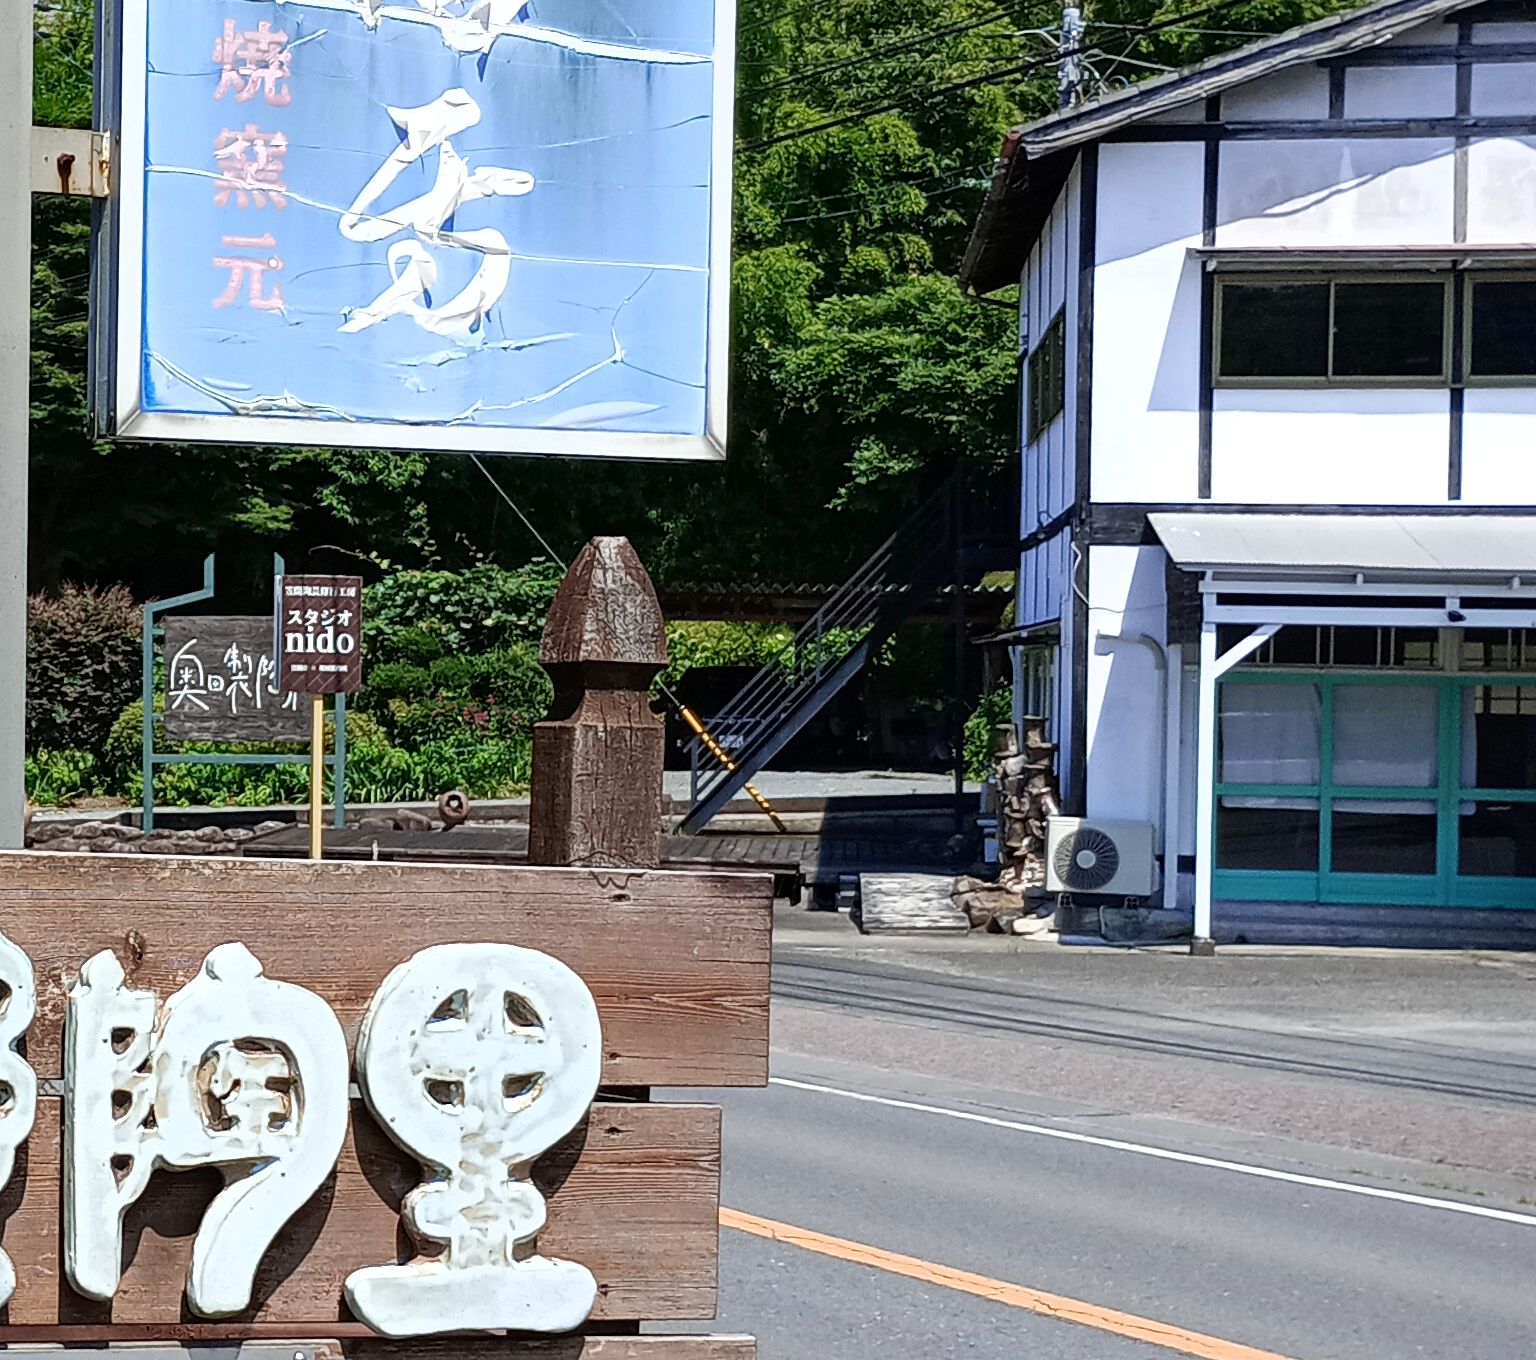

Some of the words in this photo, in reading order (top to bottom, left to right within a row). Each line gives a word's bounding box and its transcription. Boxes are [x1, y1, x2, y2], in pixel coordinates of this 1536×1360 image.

[286, 608, 353, 627] スタジオ
[284, 625, 355, 654] nido
